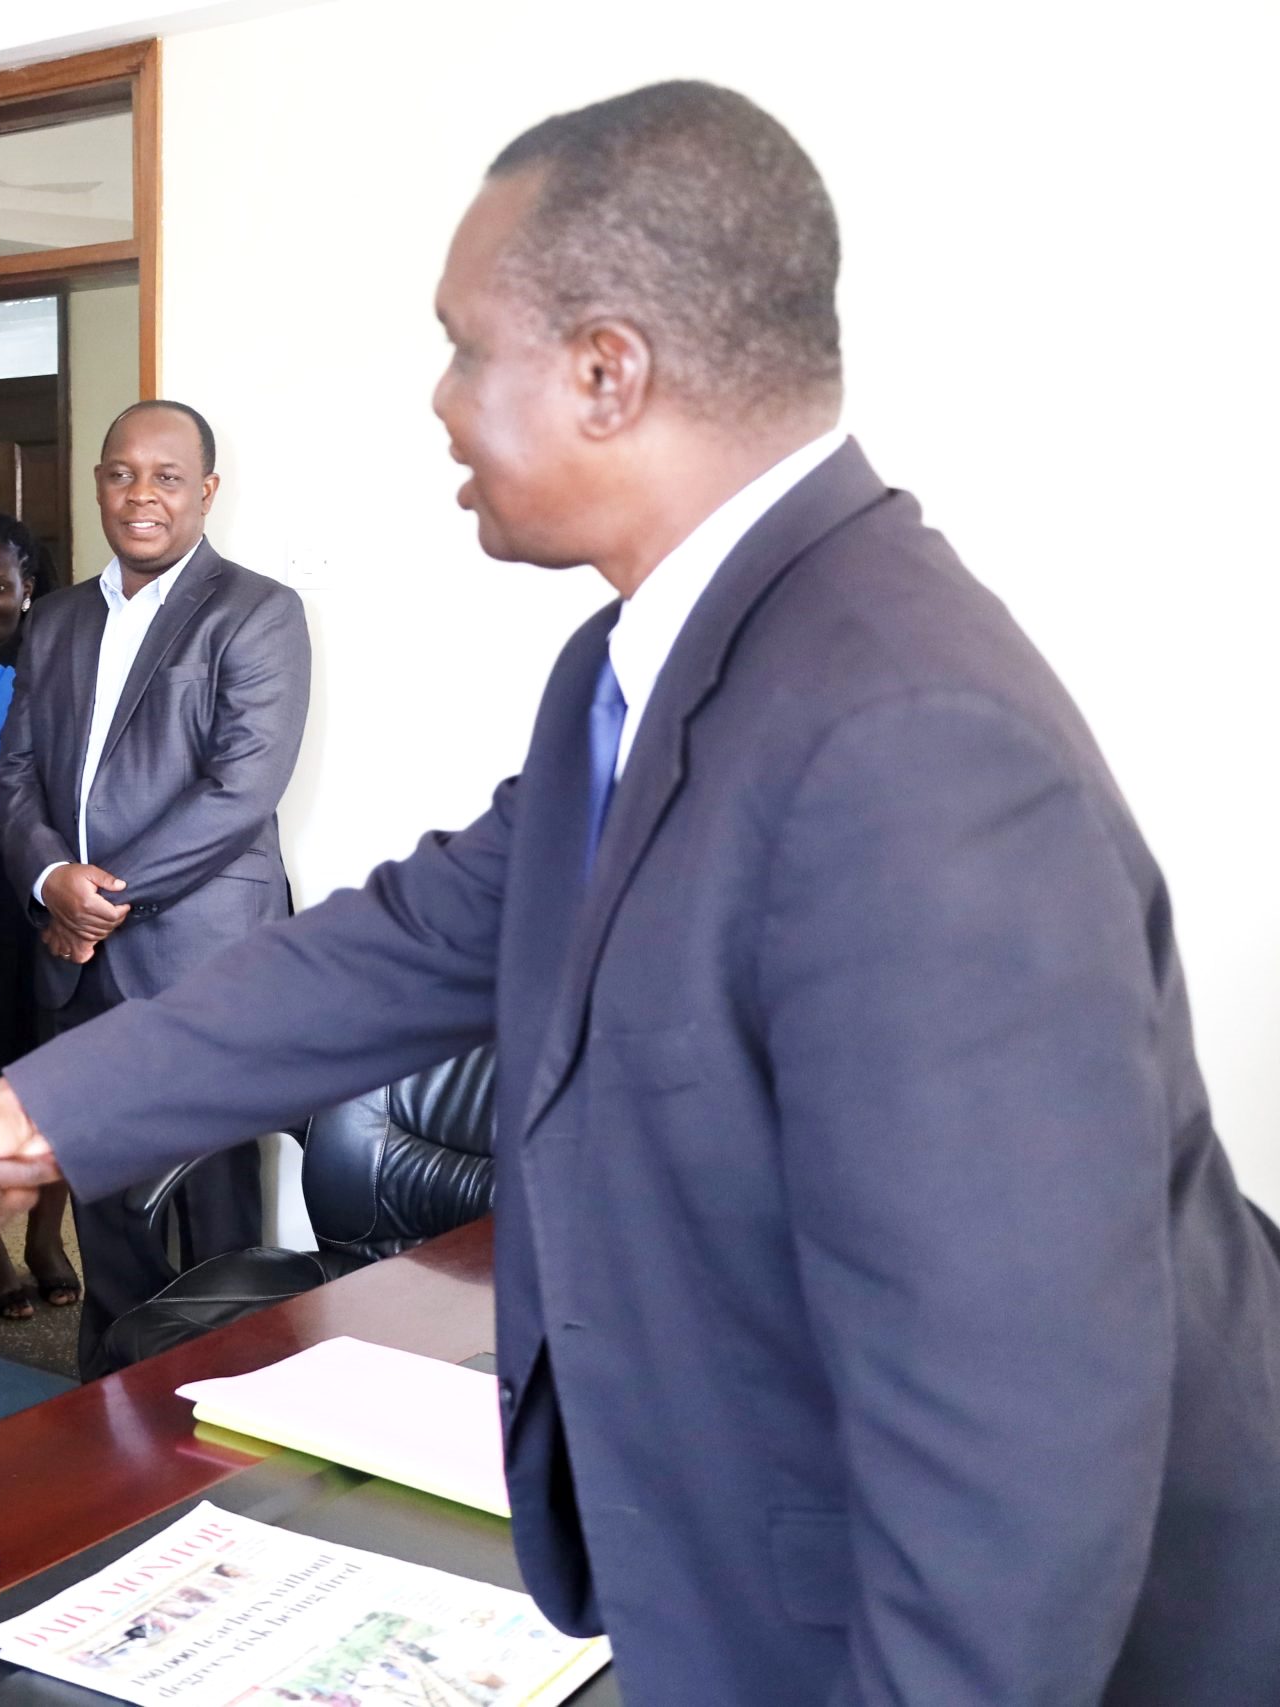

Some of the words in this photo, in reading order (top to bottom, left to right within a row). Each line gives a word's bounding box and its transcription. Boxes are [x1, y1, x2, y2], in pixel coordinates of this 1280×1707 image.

[14, 1604, 104, 1647] DAILY
[99, 1523, 233, 1595] MONITOR
[158, 1653, 237, 1698] degrees
[233, 1628, 273, 1652] risk
[264, 1593, 327, 1626] being
[314, 1562, 363, 1594] fired
[192, 1600, 273, 1649] teachers
[269, 1553, 337, 1599] without
